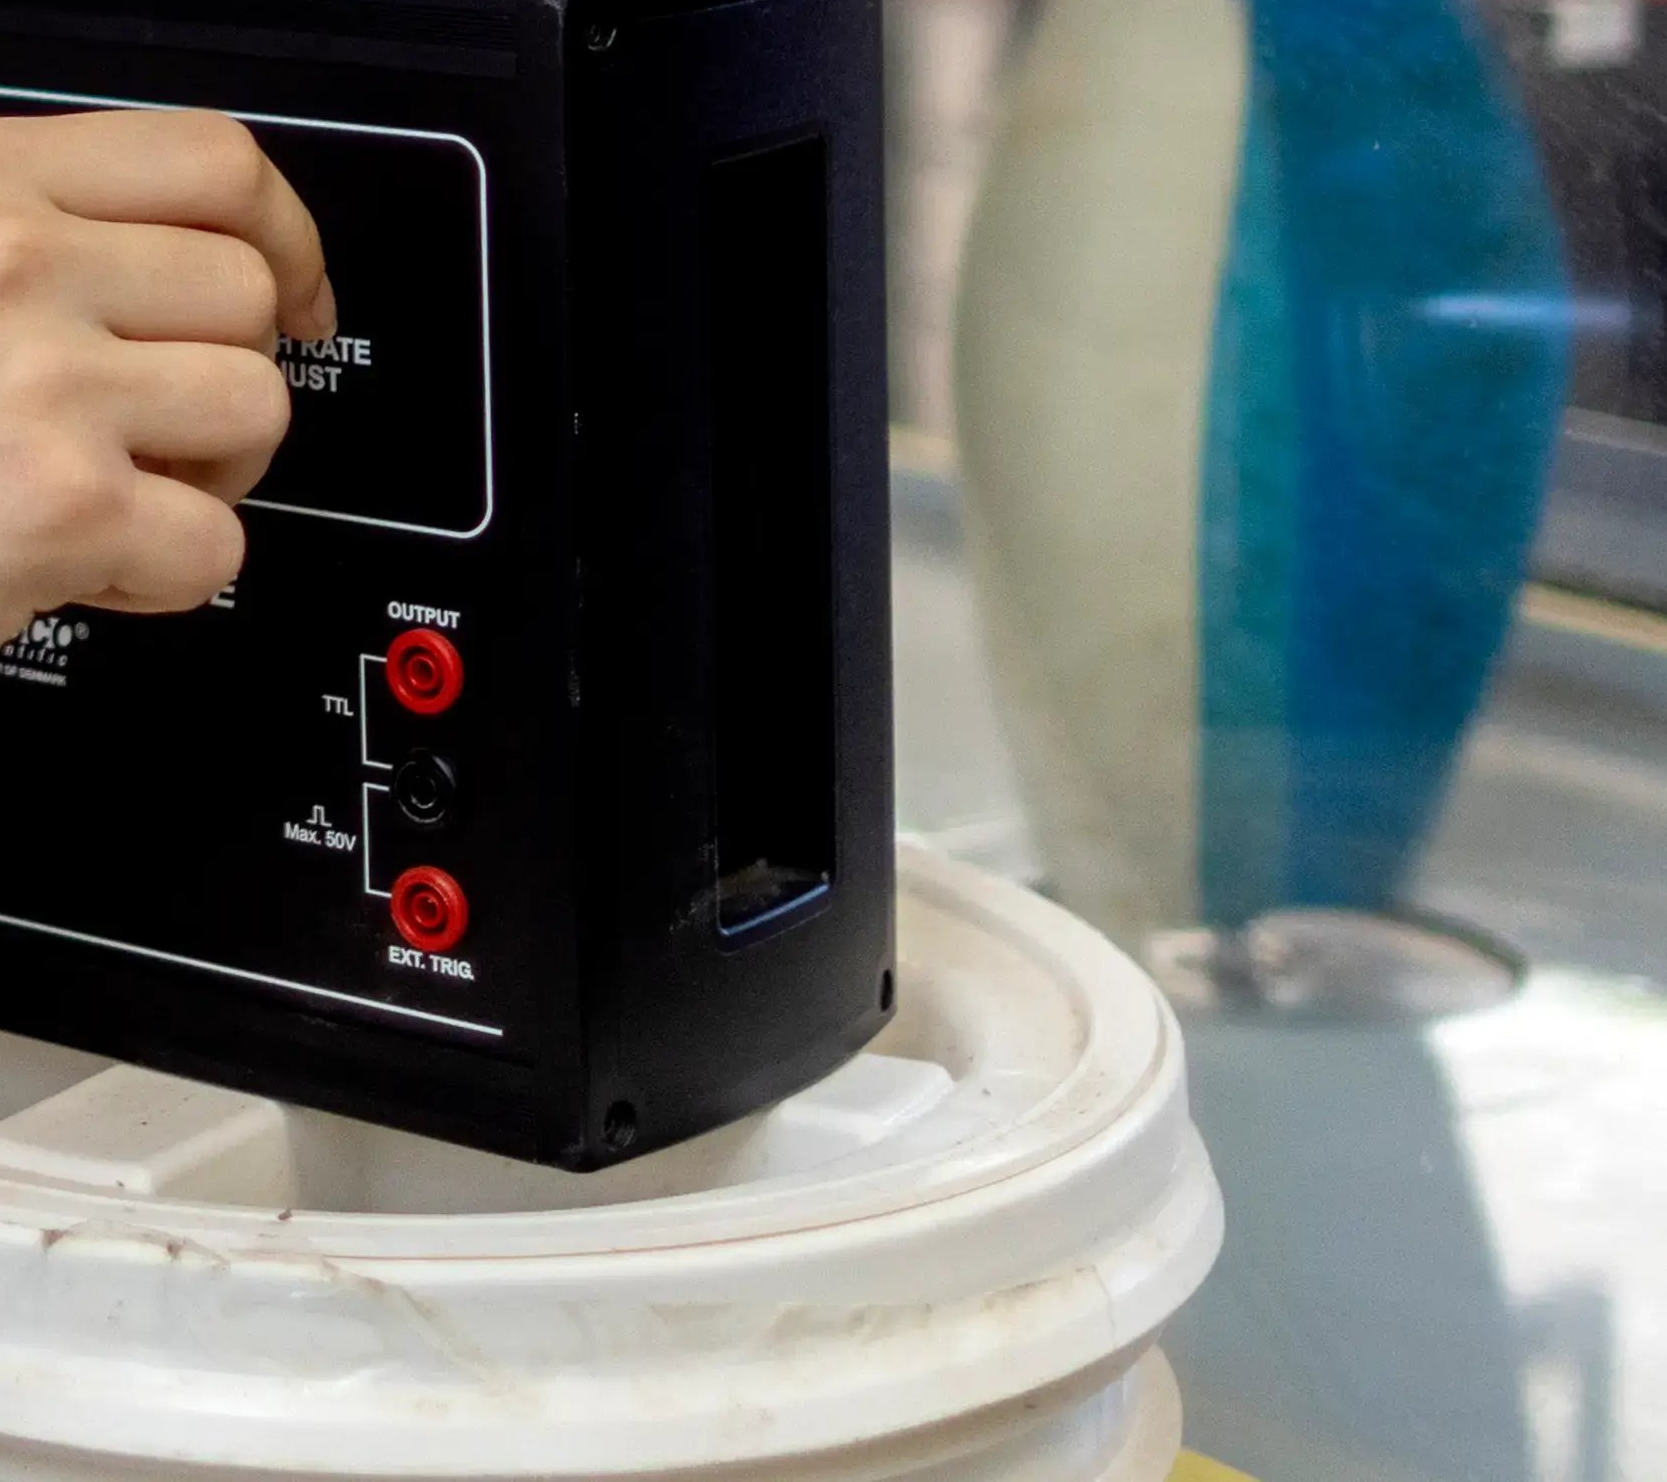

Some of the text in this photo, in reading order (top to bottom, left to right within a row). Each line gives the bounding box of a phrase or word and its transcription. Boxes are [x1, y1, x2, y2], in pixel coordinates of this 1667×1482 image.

[300, 336, 372, 366] RATE
[280, 360, 342, 393] UST
[387, 601, 461, 629] OUTPUT
[321, 694, 354, 717] TTL
[283, 821, 357, 852] Max. 50V
[388, 945, 475, 980] EXT. TRIG.
